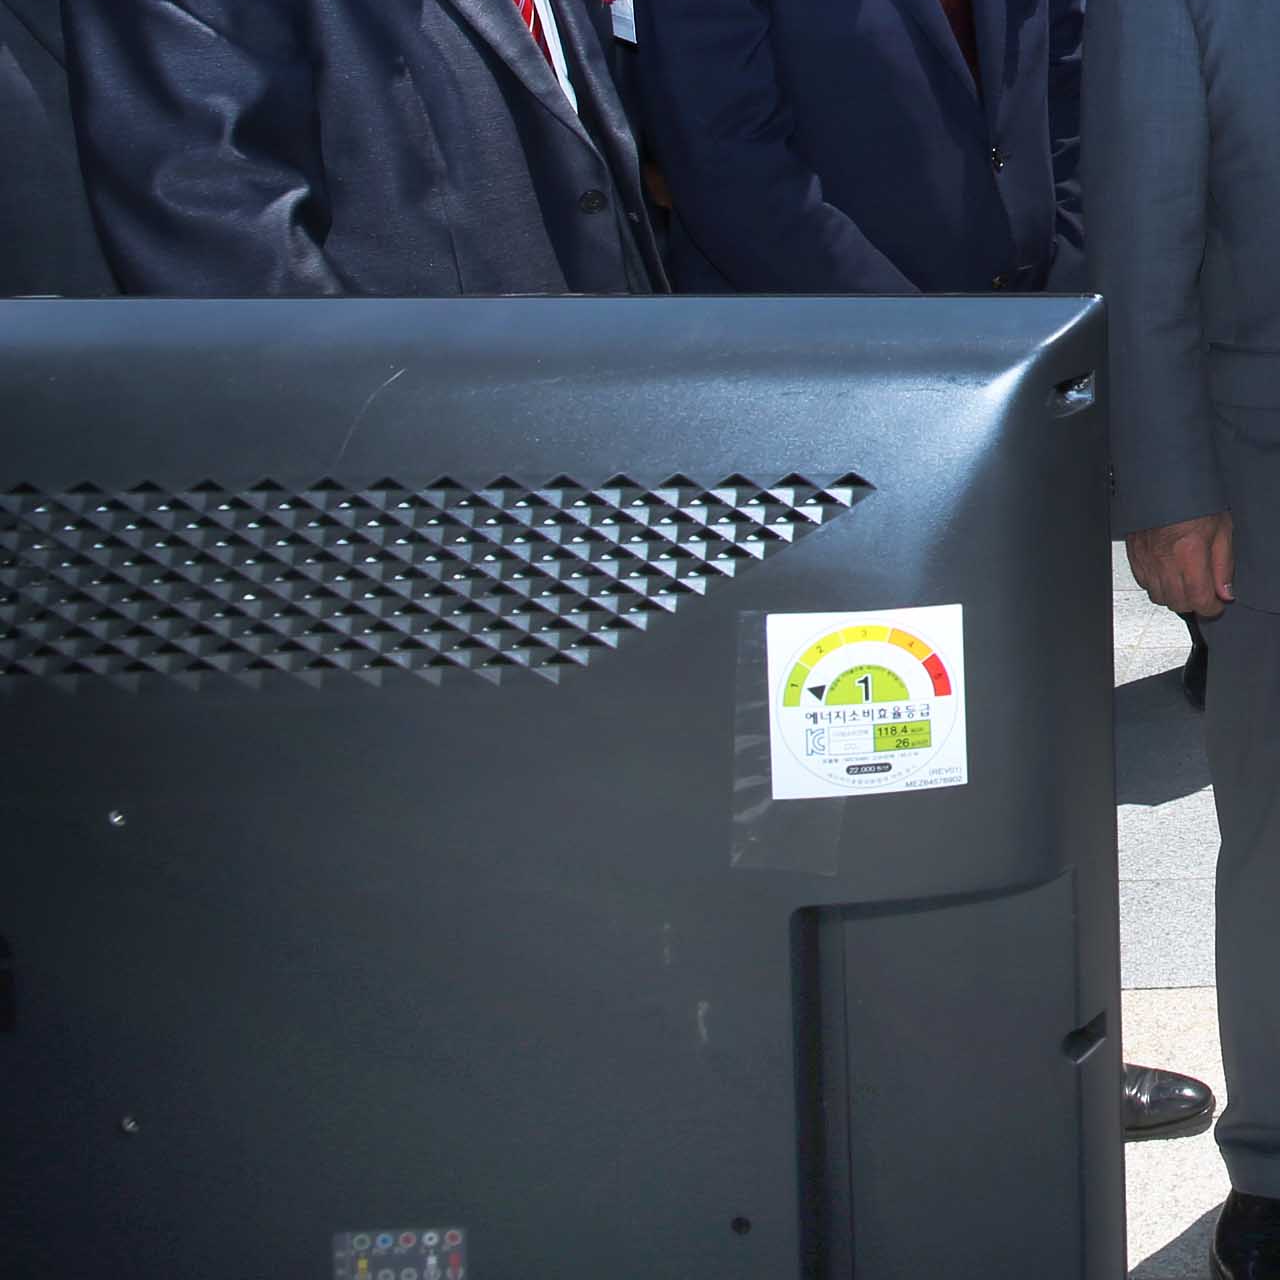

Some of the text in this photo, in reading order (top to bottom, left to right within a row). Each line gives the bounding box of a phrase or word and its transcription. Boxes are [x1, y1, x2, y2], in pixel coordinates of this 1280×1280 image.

[856, 676, 870, 701] 1
[805, 704, 930, 724] 에너지소비효율등급
[878, 725, 908, 737] 118.4
[895, 738, 909, 749] 26
